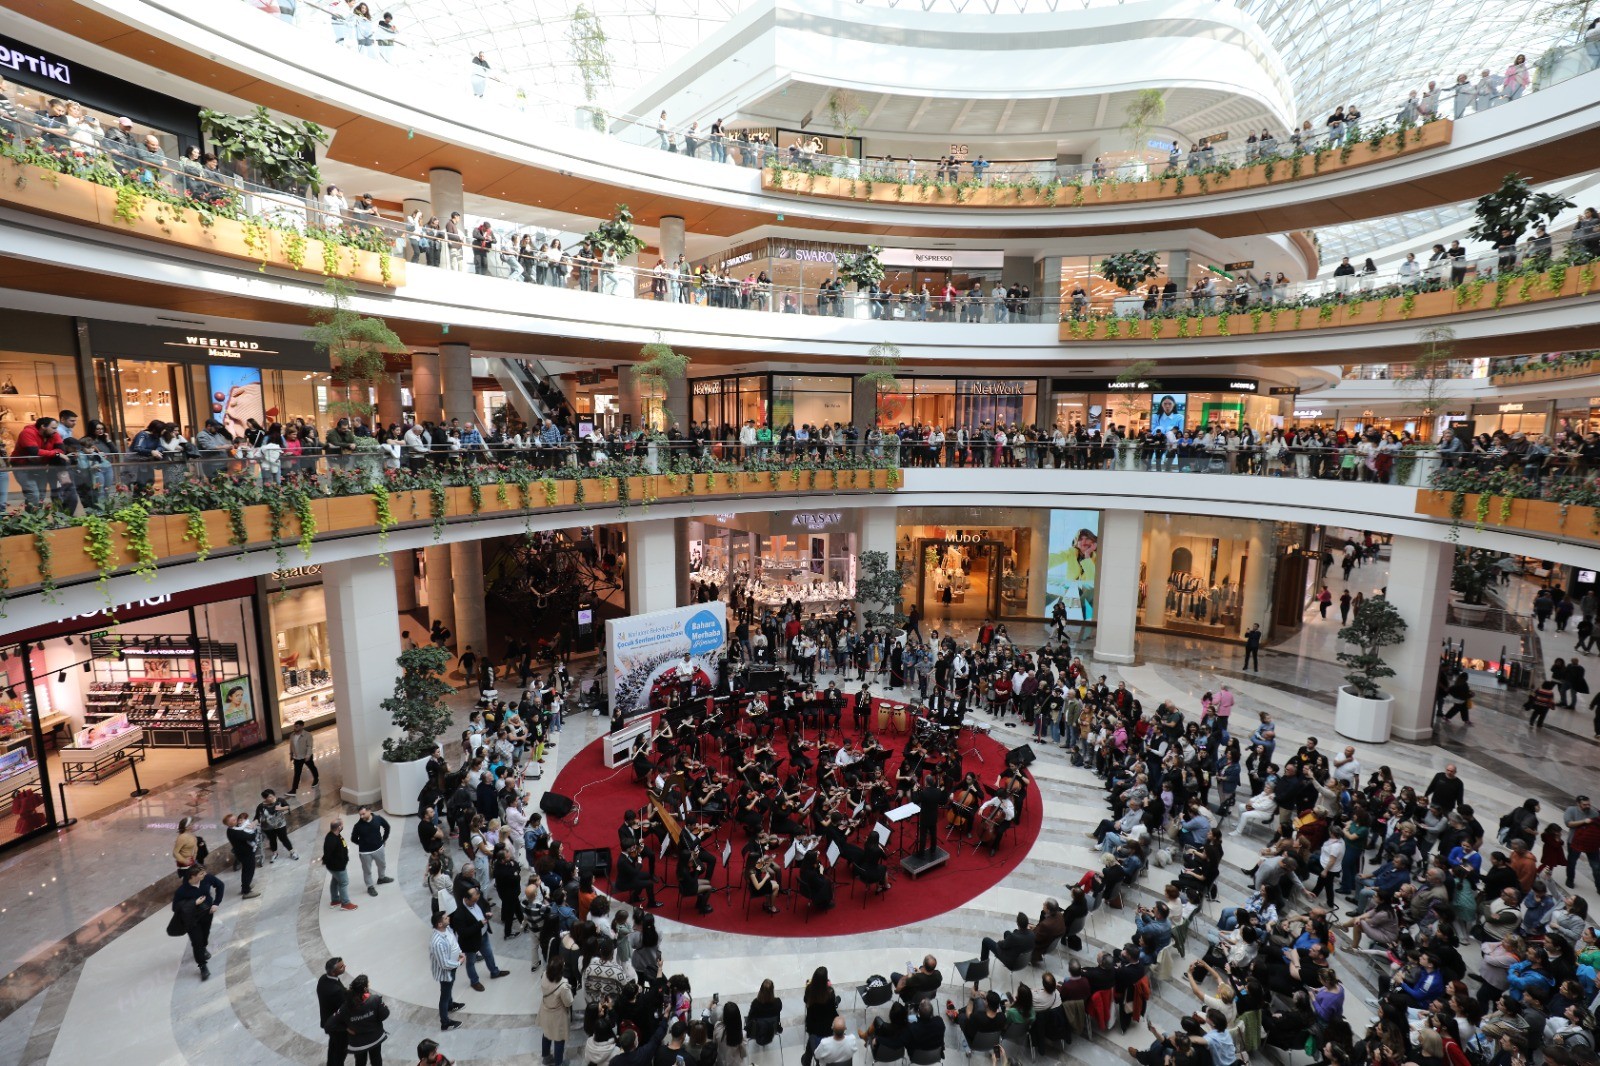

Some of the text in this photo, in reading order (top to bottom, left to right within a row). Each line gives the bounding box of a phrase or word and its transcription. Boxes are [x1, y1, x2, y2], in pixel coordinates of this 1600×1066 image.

[915, 253, 953, 262] NESPRESSO
[186, 336, 259, 350] WEEKEND
[973, 382, 1022, 395] NetWork
[792, 513, 842, 525] ATASAY
[945, 534, 981, 543] MUDO
[691, 621, 716, 630] Bahara
[691, 629, 721, 640] Merhaba
[617, 640, 635, 649] Çocuk
[635, 635, 656, 645] Senfoni
